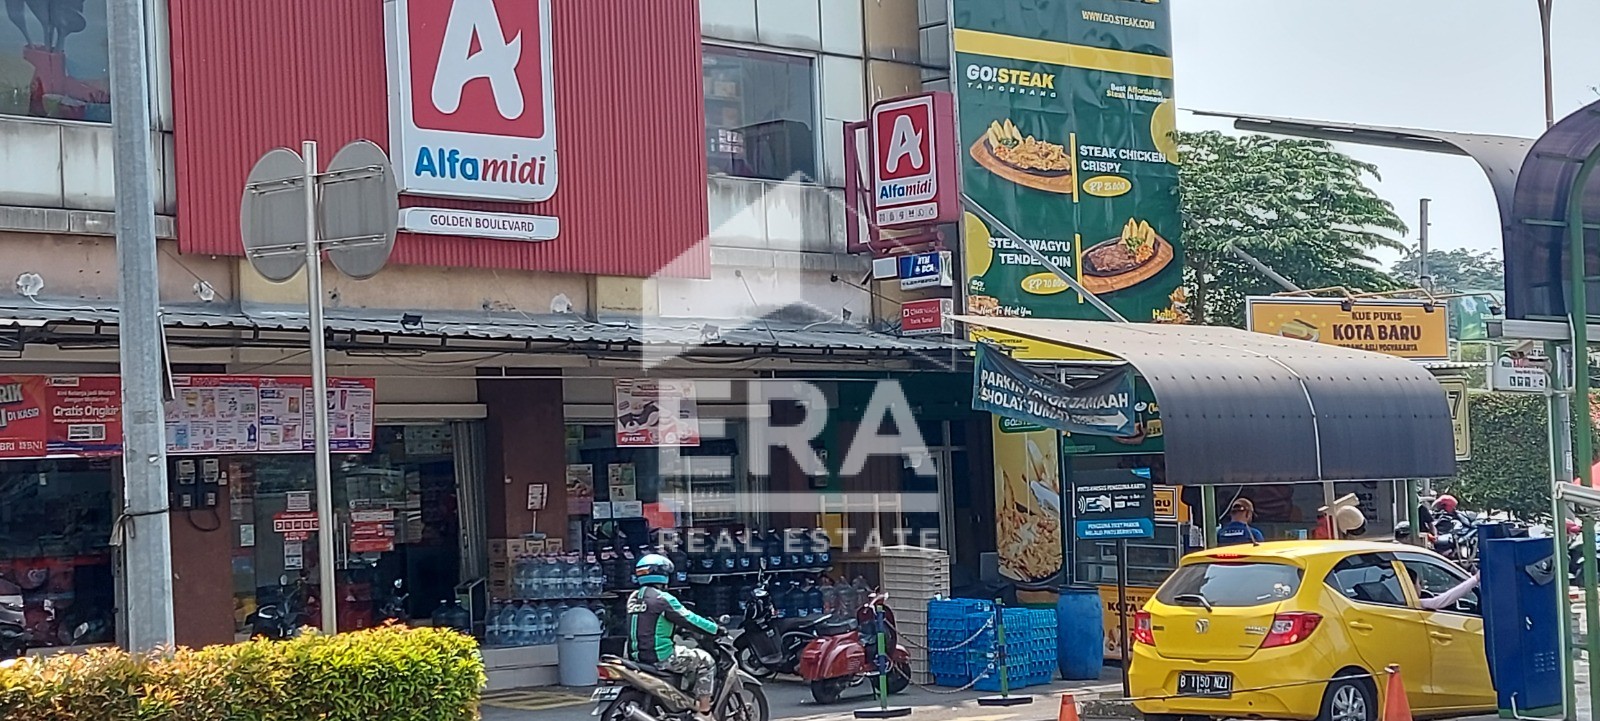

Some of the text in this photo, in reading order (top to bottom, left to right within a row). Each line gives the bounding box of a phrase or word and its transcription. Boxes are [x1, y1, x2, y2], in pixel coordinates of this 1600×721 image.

[1081, 10, 1155, 29] WWW.GO.STEAK.COM
[431, 0, 525, 120] A
[966, 65, 1055, 89] GO!STEAK
[967, 83, 1057, 98] TANGERANG
[886, 115, 923, 173] A
[1080, 145, 1167, 163] STEAK CHICKEN
[415, 146, 546, 186] Alfamidi
[1081, 161, 1122, 174] CRISPY
[880, 179, 932, 200] Alfamidi
[430, 214, 535, 233] GOLDEN BOULEVARD
[988, 237, 1071, 252] STEA WAGYU
[999, 253, 1072, 268] TENDEOIN
[1351, 311, 1403, 321] KUE PUKIS
[1332, 324, 1422, 341] KOTA BARU
[1069, 391, 1129, 410] JAMAAH
[53, 405, 119, 418] Gratis Ongkir
[1180, 675, 1186, 688] B
